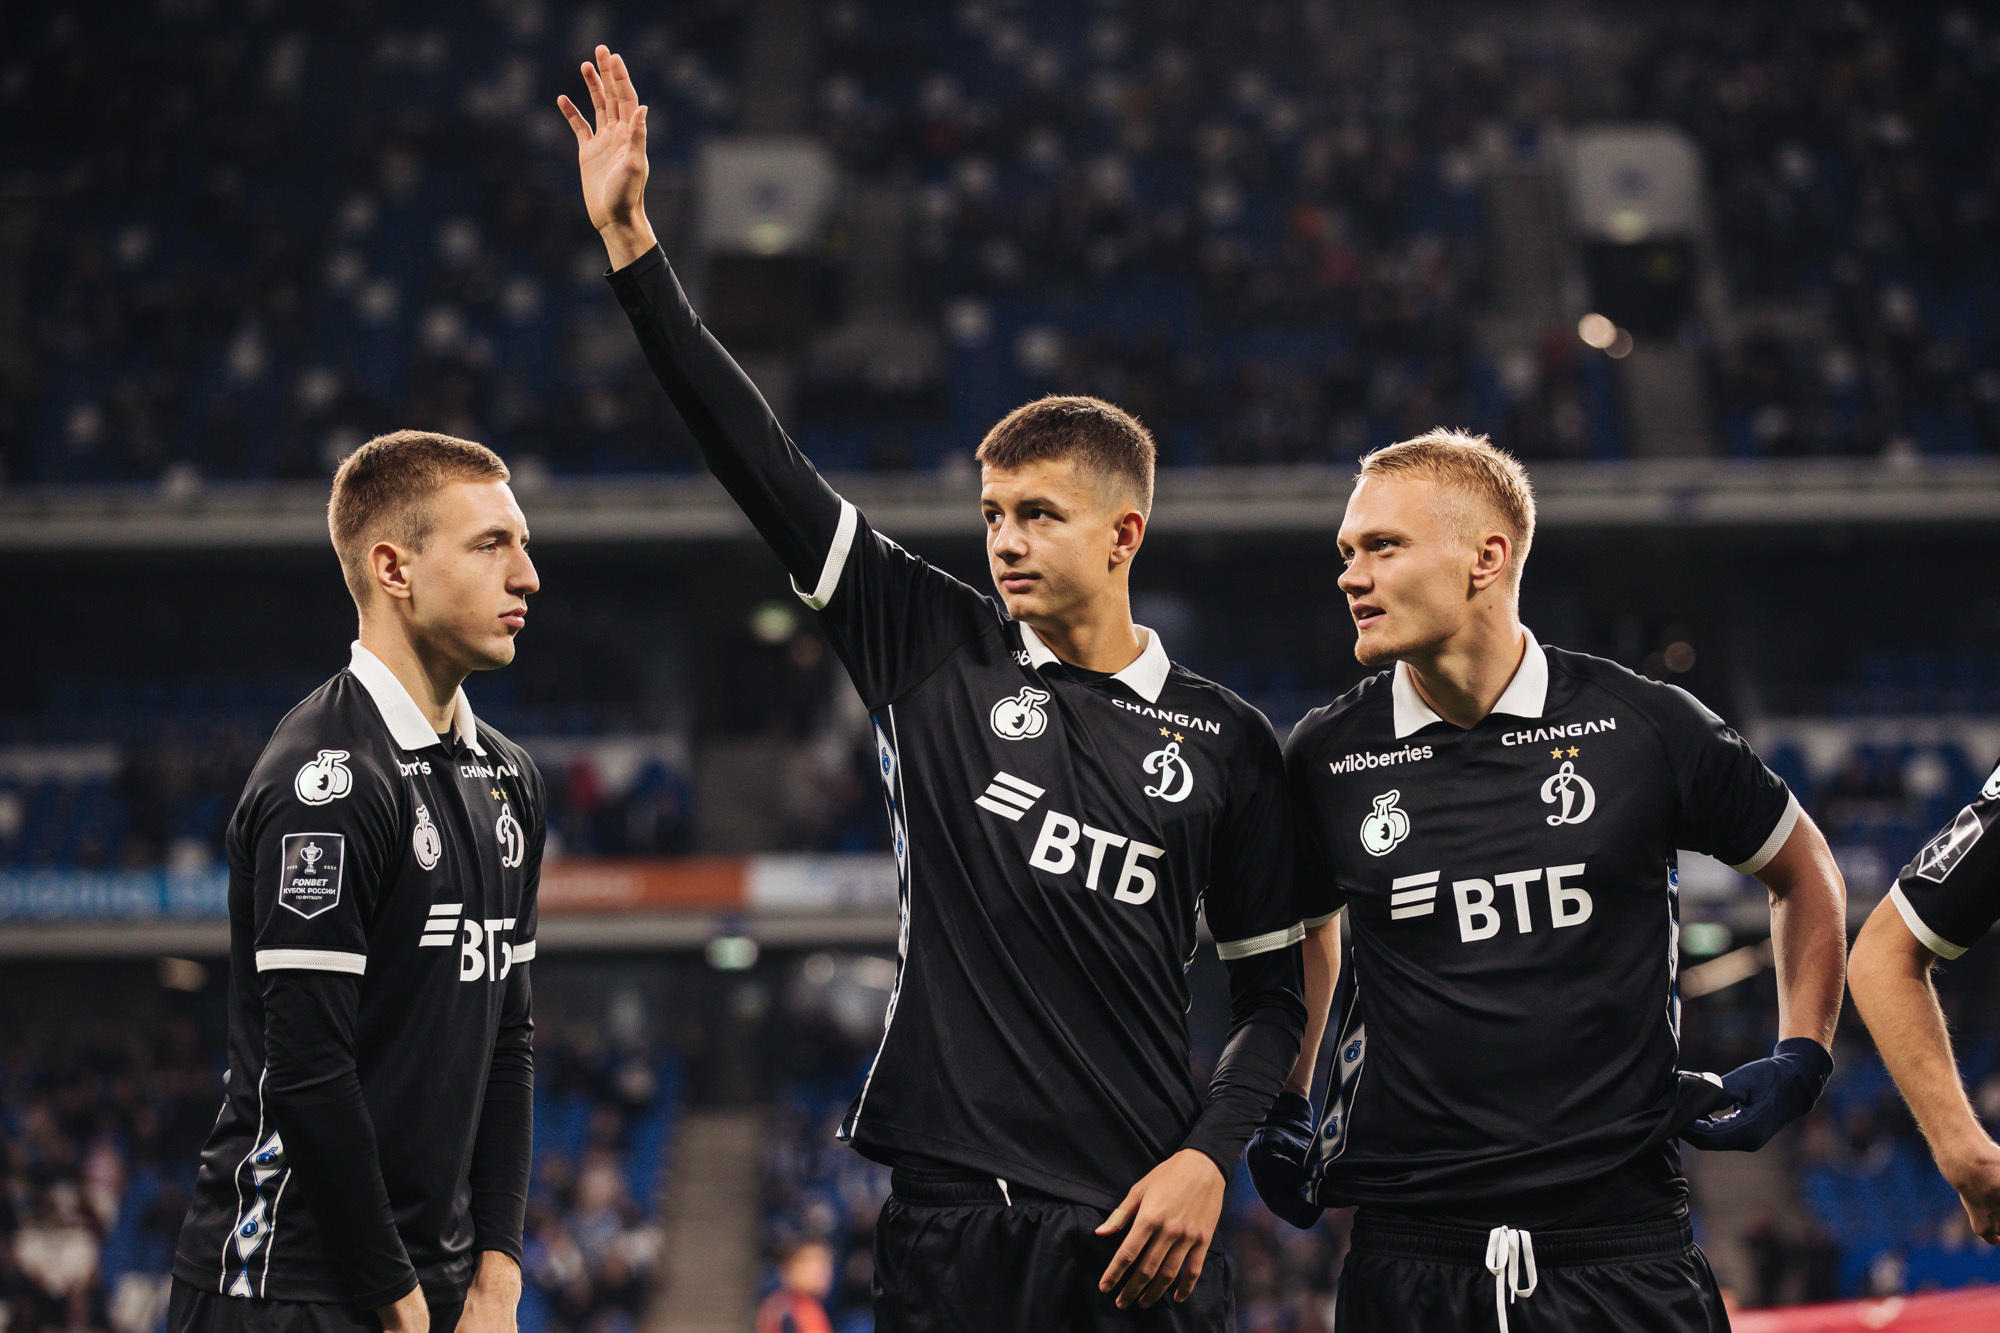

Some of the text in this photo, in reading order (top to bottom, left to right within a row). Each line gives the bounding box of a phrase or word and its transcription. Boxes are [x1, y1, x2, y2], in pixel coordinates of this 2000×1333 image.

[1111, 697, 1222, 735] CHANGAN
[1501, 716, 1618, 747] CHANGAN
[460, 763, 519, 780] CHANAN
[1328, 744, 1434, 775] wildberries
[1028, 809, 1166, 906] ВТБ
[292, 878, 328, 886] FONBET
[1451, 862, 1593, 943] ВТБ
